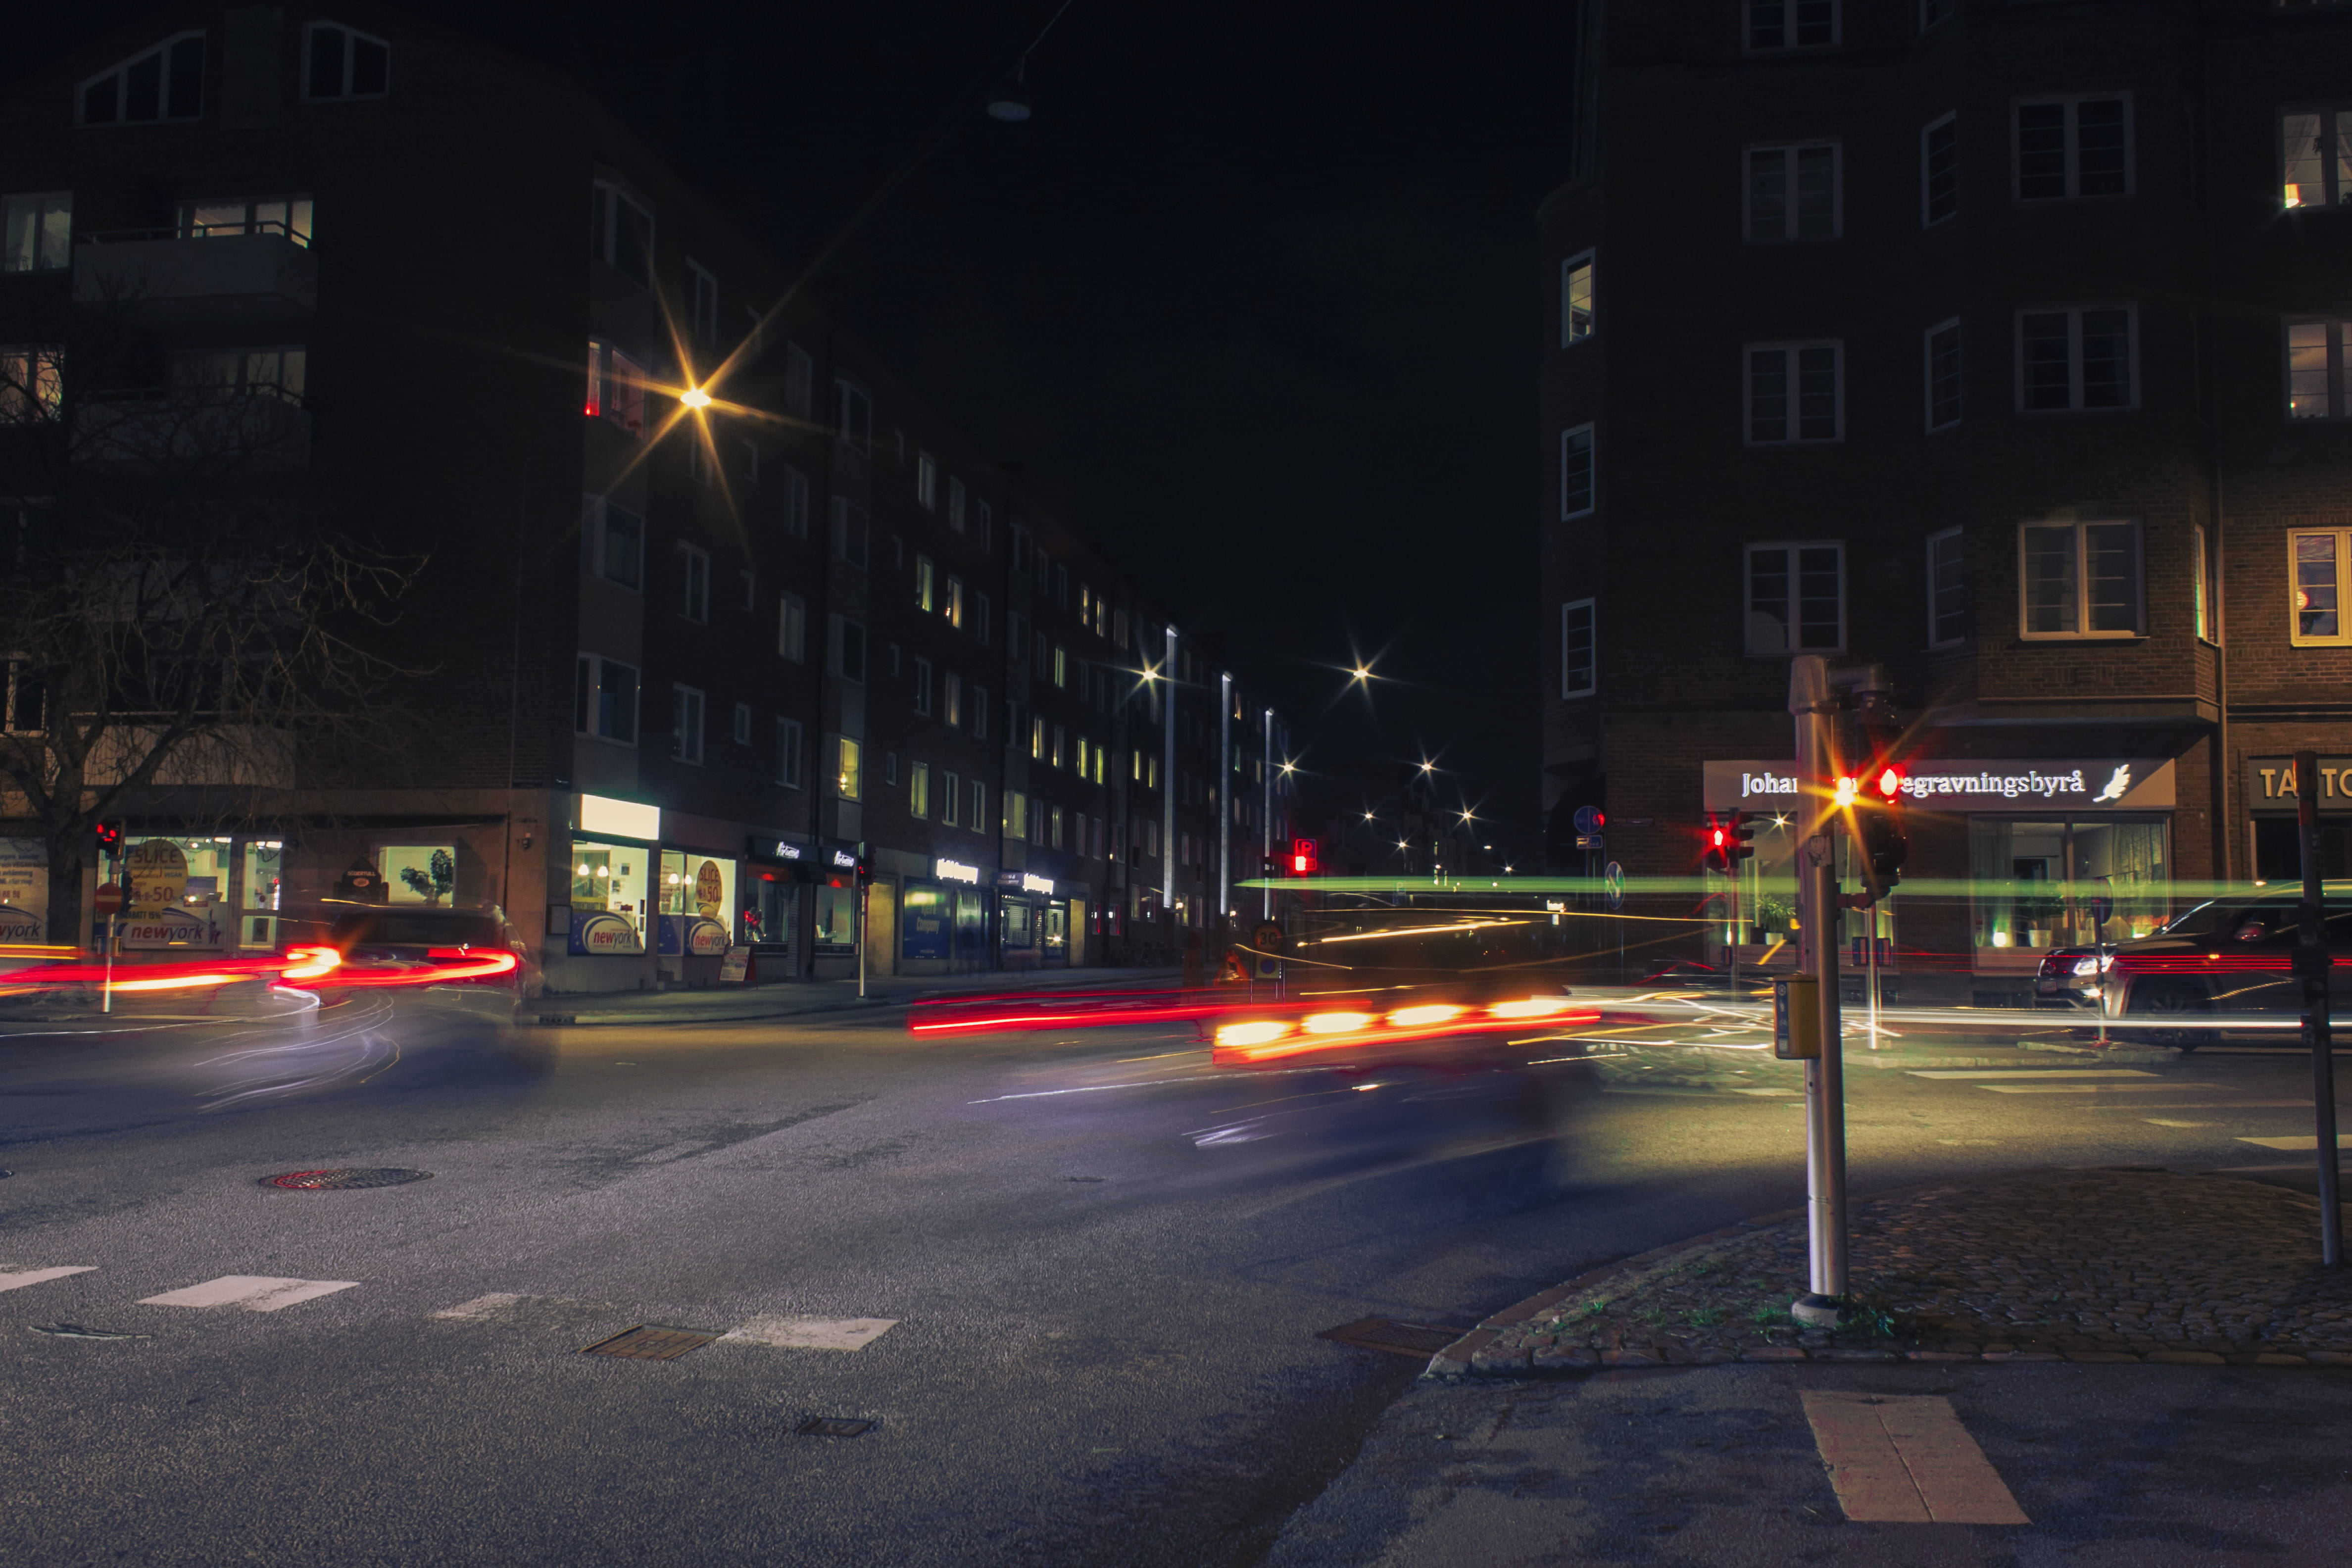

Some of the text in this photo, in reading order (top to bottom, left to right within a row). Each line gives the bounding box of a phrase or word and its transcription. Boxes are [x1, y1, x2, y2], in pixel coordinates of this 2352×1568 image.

[1901, 770, 2085, 798] egravningsbyrå
[134, 848, 179, 864] SLICE
[699, 867, 719, 882] SLICE
[153, 886, 173, 902] 50
[707, 886, 719, 903] 50
[131, 924, 204, 942] newyork
[593, 930, 633, 949] newyork
[1260, 931, 1277, 945] 30
